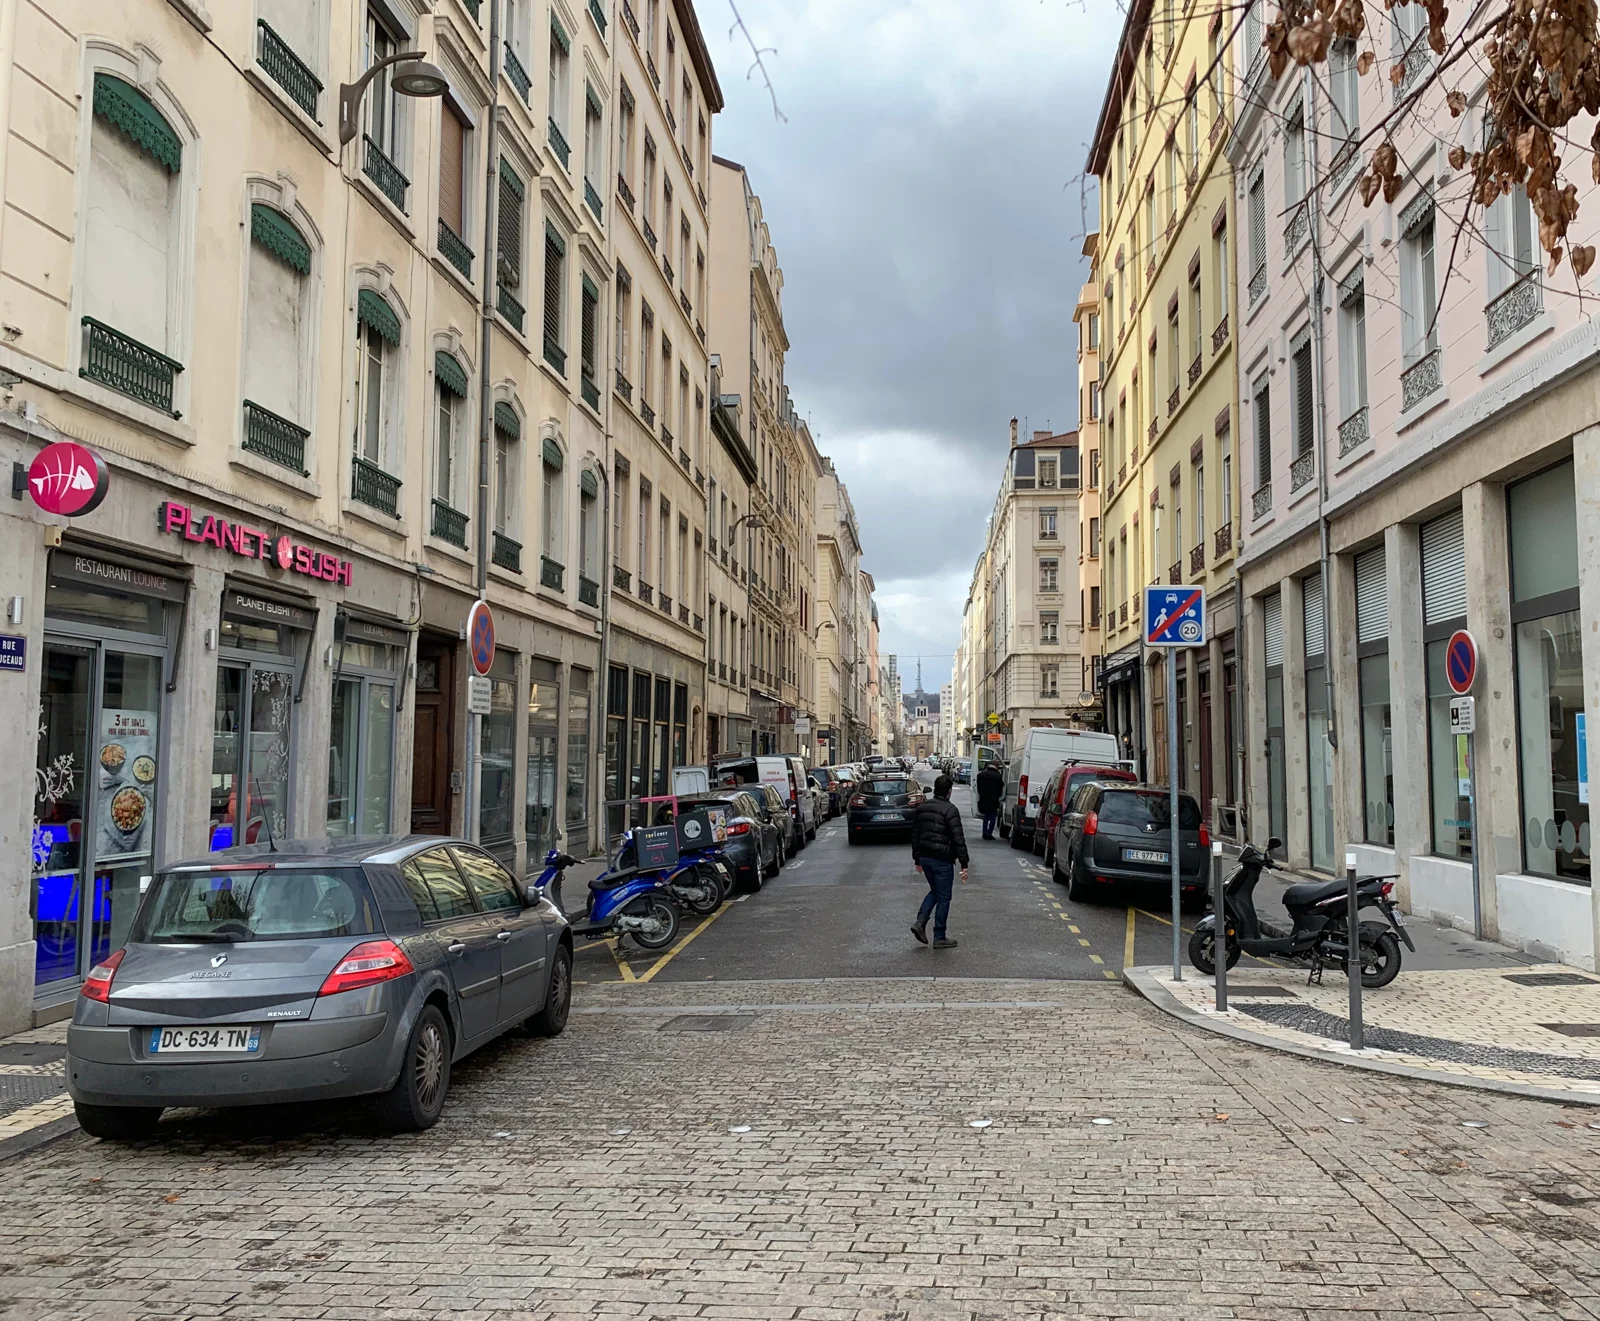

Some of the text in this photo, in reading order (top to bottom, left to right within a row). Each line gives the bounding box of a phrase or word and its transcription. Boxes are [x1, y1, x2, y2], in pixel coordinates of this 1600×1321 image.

[161, 501, 353, 587] PLANET SUSHI
[75, 556, 167, 591] RESTAURANT LOUNGE
[236, 595, 266, 612] PLANET
[266, 603, 290, 617] SUSHI
[1183, 626, 1197, 635] 20
[2, 640, 16, 651] RUE
[0, 654, 23, 666] UGEAUD
[115, 714, 121, 726] 3
[1131, 850, 1164, 860] EE-977-YR
[248, 1038, 258, 1049] 69
